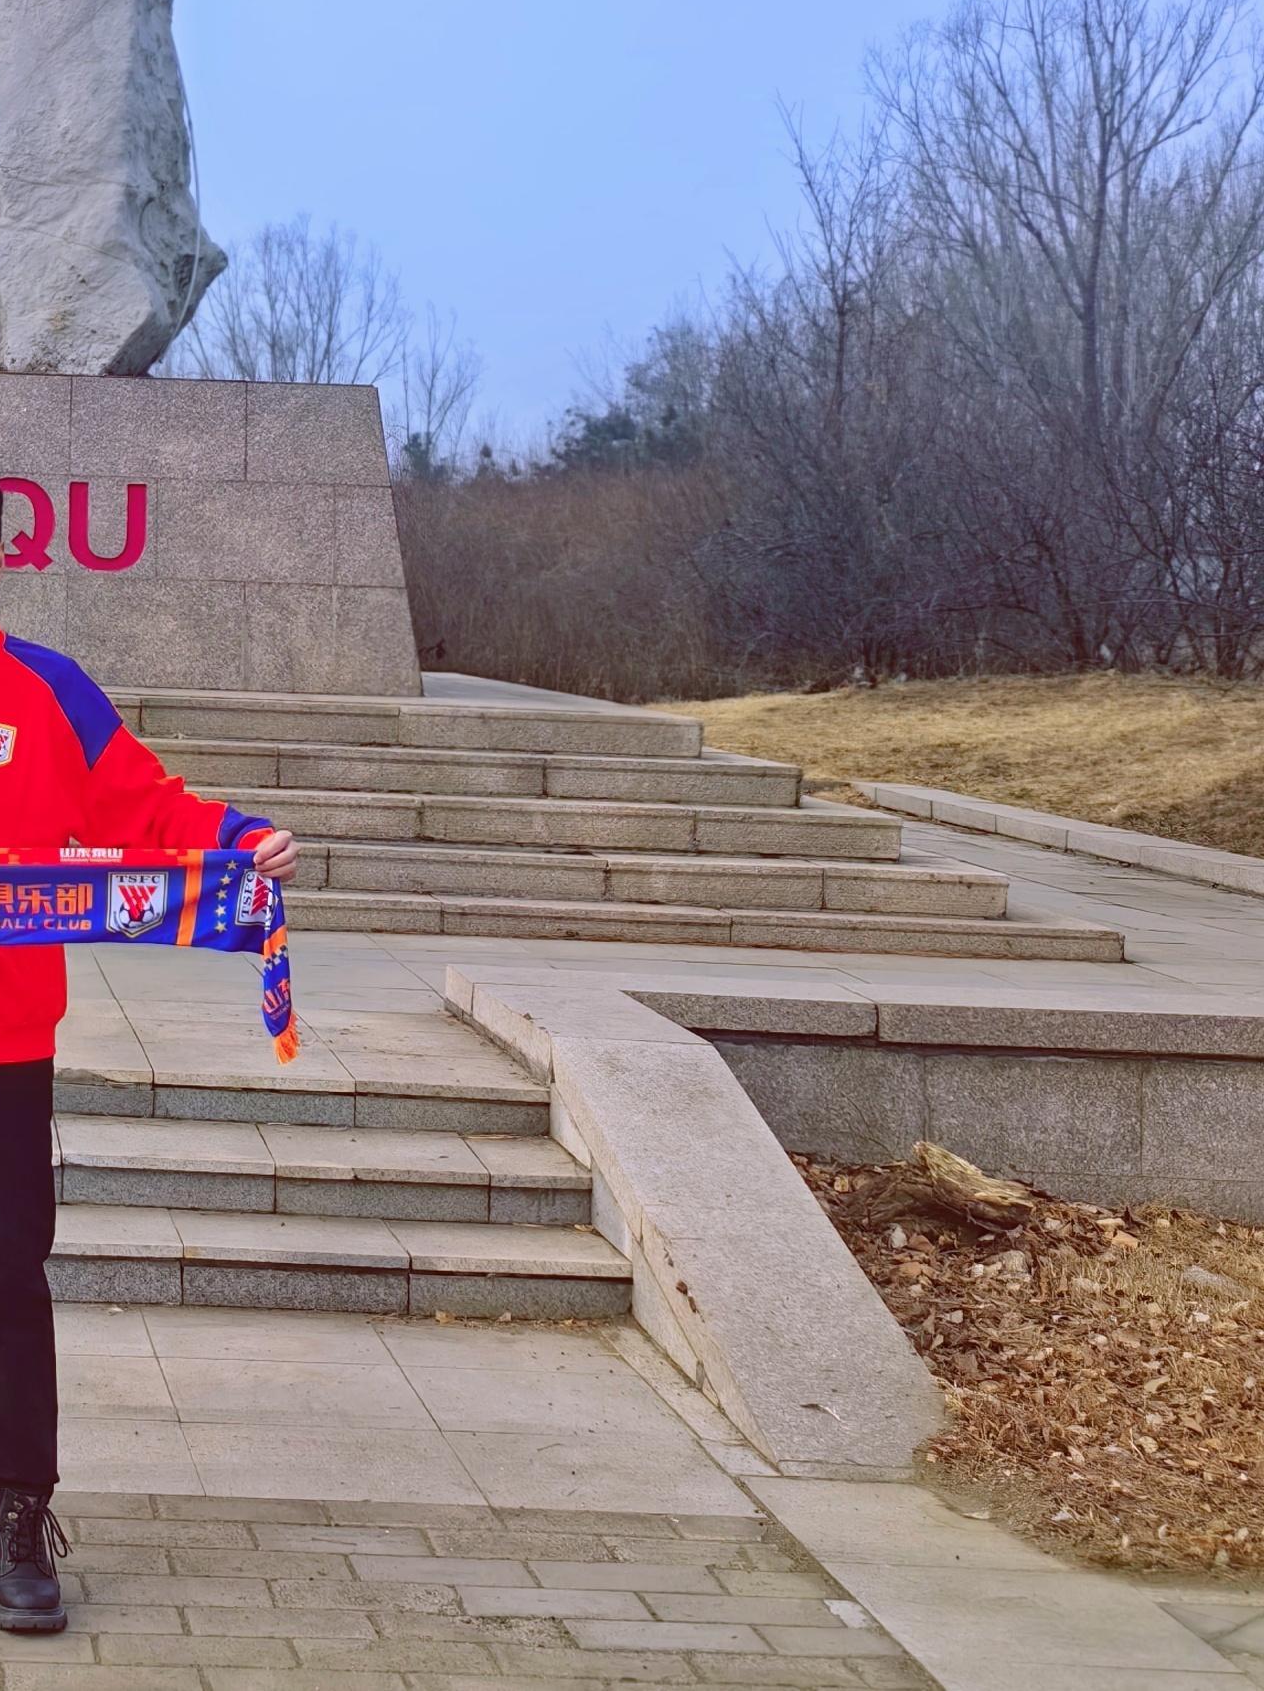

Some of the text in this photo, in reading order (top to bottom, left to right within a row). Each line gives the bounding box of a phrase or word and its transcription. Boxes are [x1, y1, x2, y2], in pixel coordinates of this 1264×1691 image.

[0, 476, 147, 572] QU
[116, 875, 161, 884] TSFC
[240, 872, 255, 917] TSFC
[43, 918, 93, 931] CLUB
